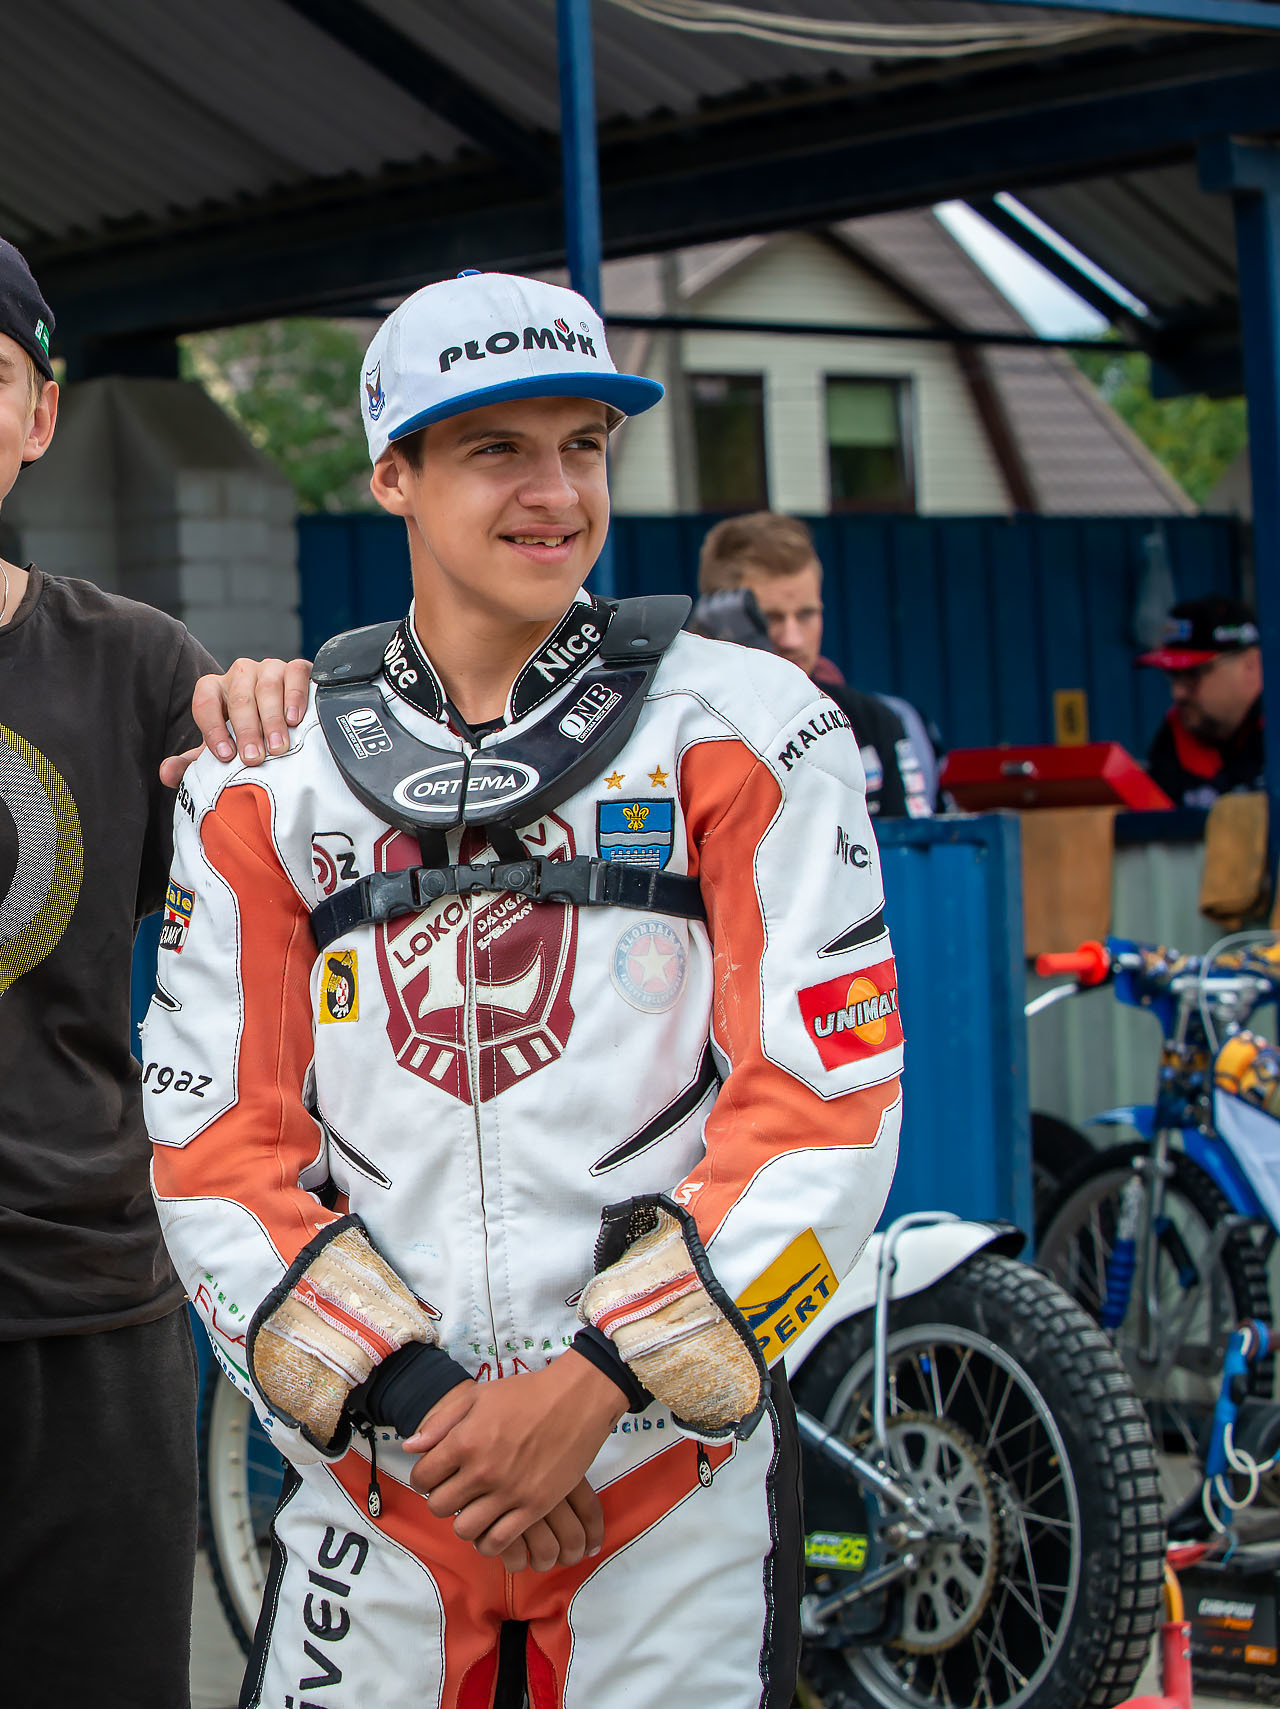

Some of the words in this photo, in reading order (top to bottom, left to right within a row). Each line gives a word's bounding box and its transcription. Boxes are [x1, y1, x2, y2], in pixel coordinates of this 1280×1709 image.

[439, 325, 597, 373] PŁOMYK
[384, 630, 418, 689] Nice
[534, 622, 601, 682] Nice
[413, 773, 517, 796] ORTEMA
[814, 987, 898, 1038] UNIMAX
